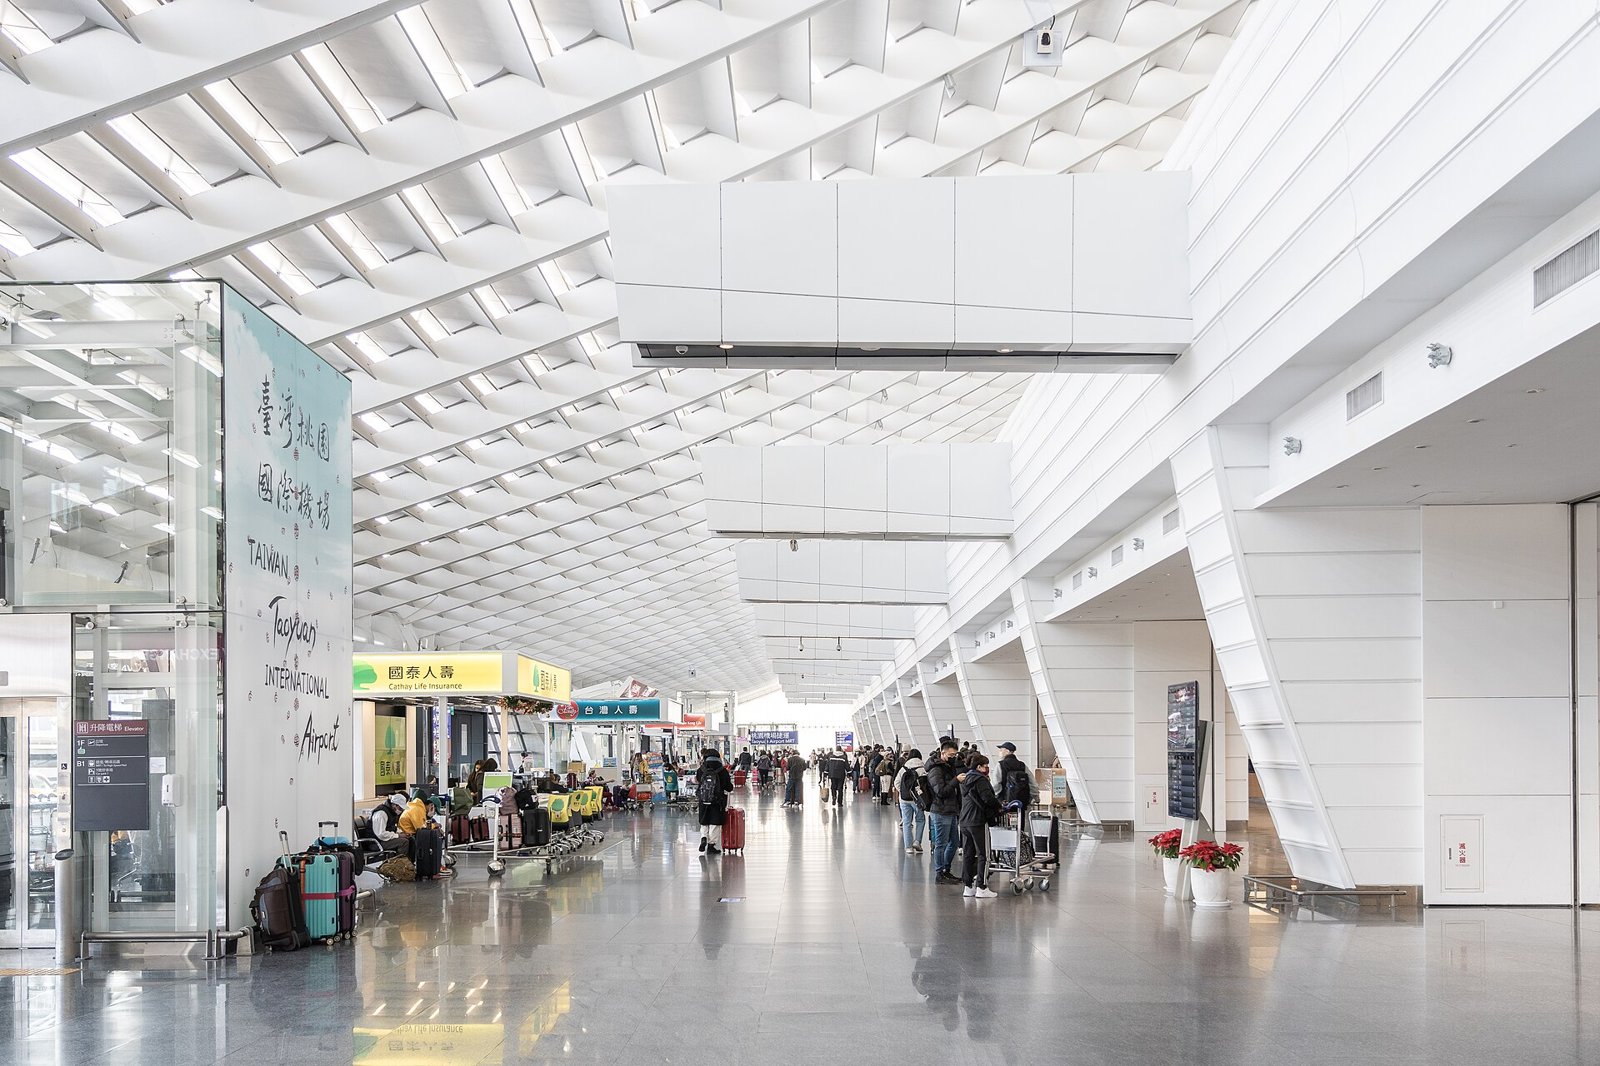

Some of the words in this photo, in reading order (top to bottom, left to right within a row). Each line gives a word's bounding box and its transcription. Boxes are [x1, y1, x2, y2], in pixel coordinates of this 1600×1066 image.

[257, 373, 330, 462] 臺灣桃園
[257, 460, 330, 530] 國際機場
[247, 535, 289, 580] TAIWAN
[268, 595, 317, 658] Taoyuan
[264, 664, 330, 700] INTERNATIONAL
[388, 665, 455, 680] 國泰人壽
[388, 683, 412, 691] Cathay
[89, 723, 123, 732] 升降電梯
[584, 705, 638, 715] 台灣人壽
[298, 711, 339, 765] Airport
